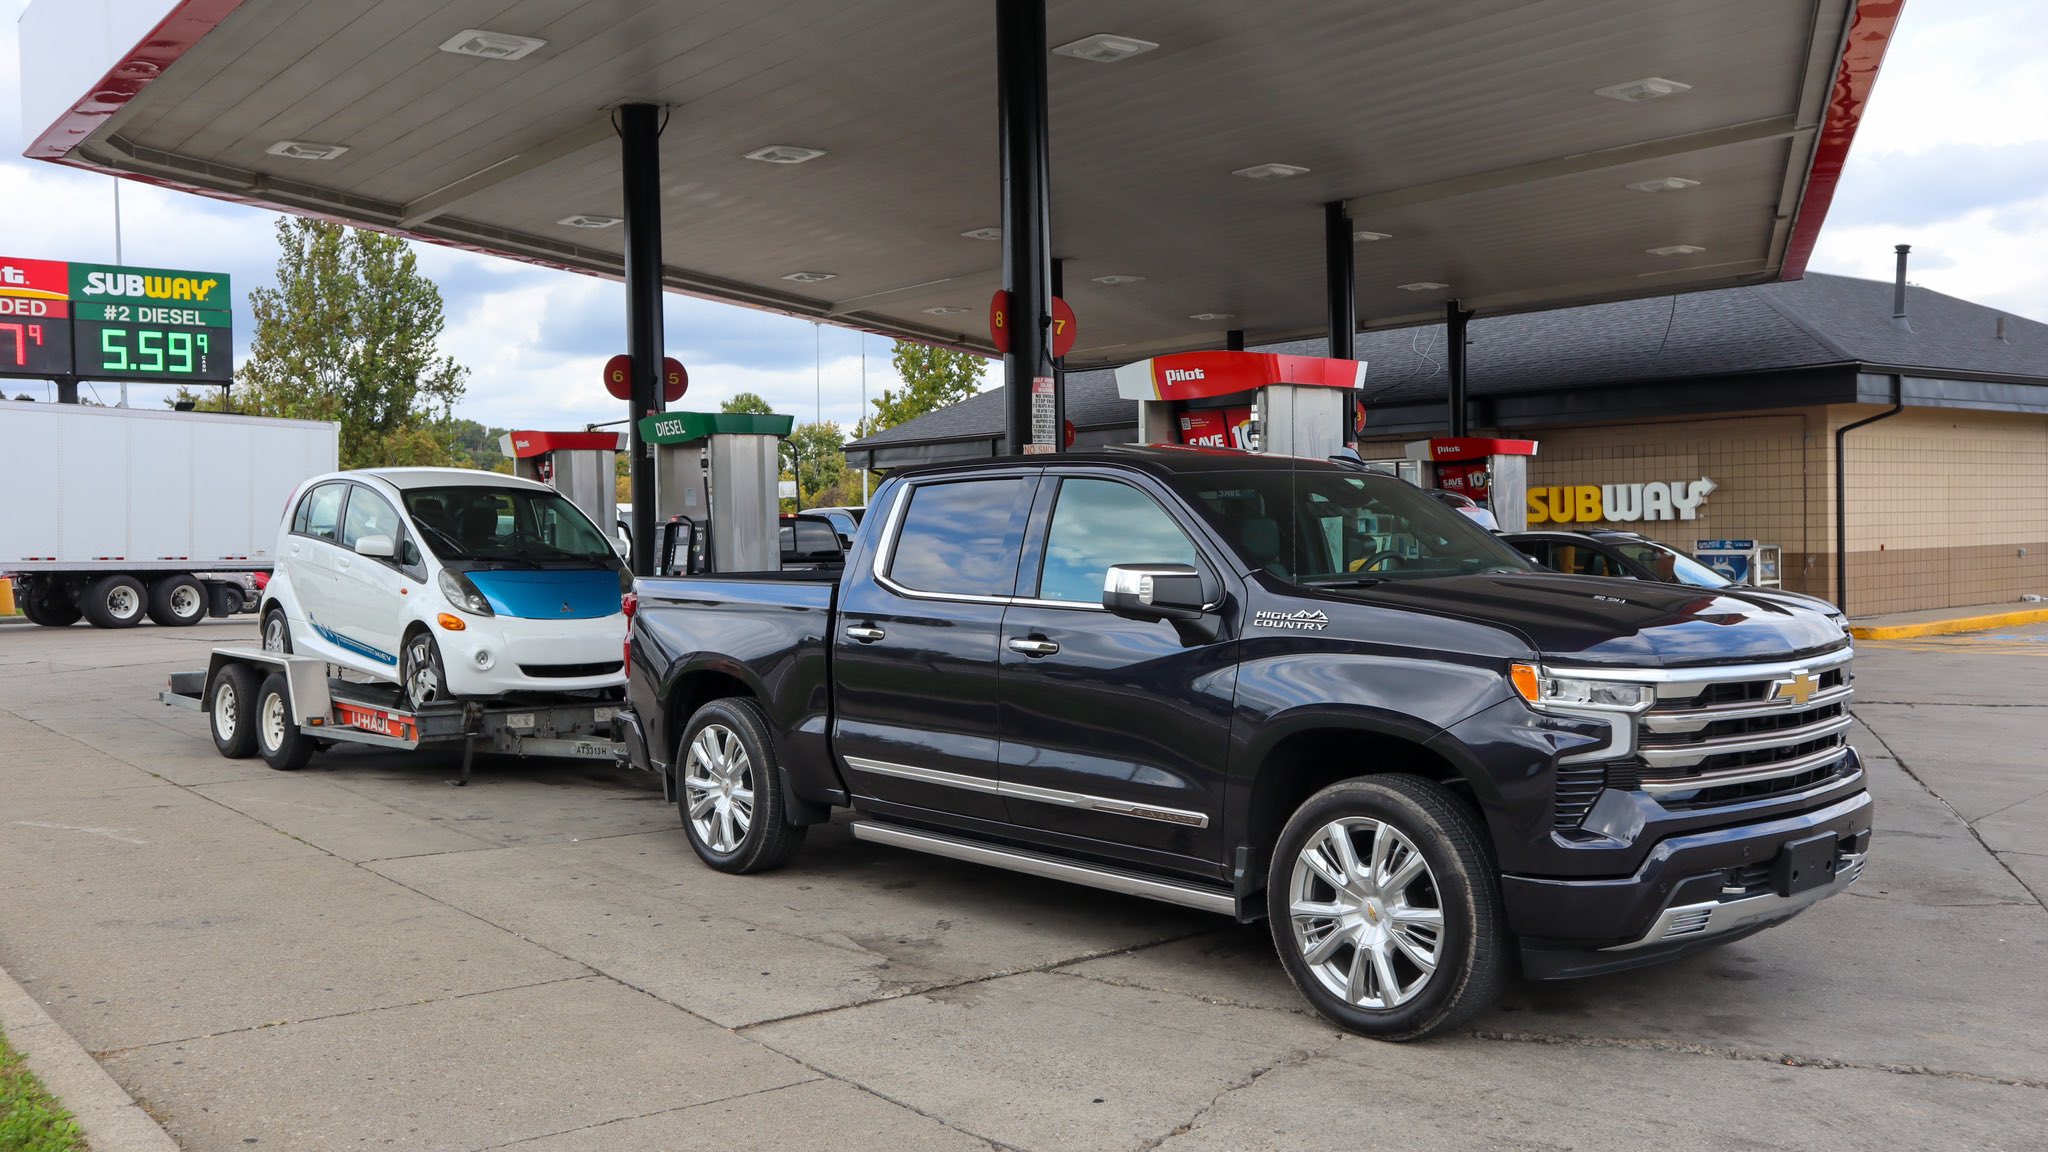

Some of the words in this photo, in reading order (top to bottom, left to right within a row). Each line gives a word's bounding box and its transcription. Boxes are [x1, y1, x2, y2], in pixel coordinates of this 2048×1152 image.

[82, 272, 217, 301] SUBWAY
[104, 305, 130, 321] #2
[138, 307, 206, 325] DIESEL
[996, 311, 1003, 328] 8
[1054, 319, 1066, 335] 7
[612, 370, 624, 382] 6
[668, 373, 679, 384] 5
[655, 419, 686, 436] DIESEL
[1443, 477, 1464, 487] SAVE
[1527, 479, 1717, 523] SUBWAY
[1256, 610, 1291, 620] HIGH
[1254, 619, 1328, 631] COUNTRY
[352, 711, 392, 734] U-HAUL
